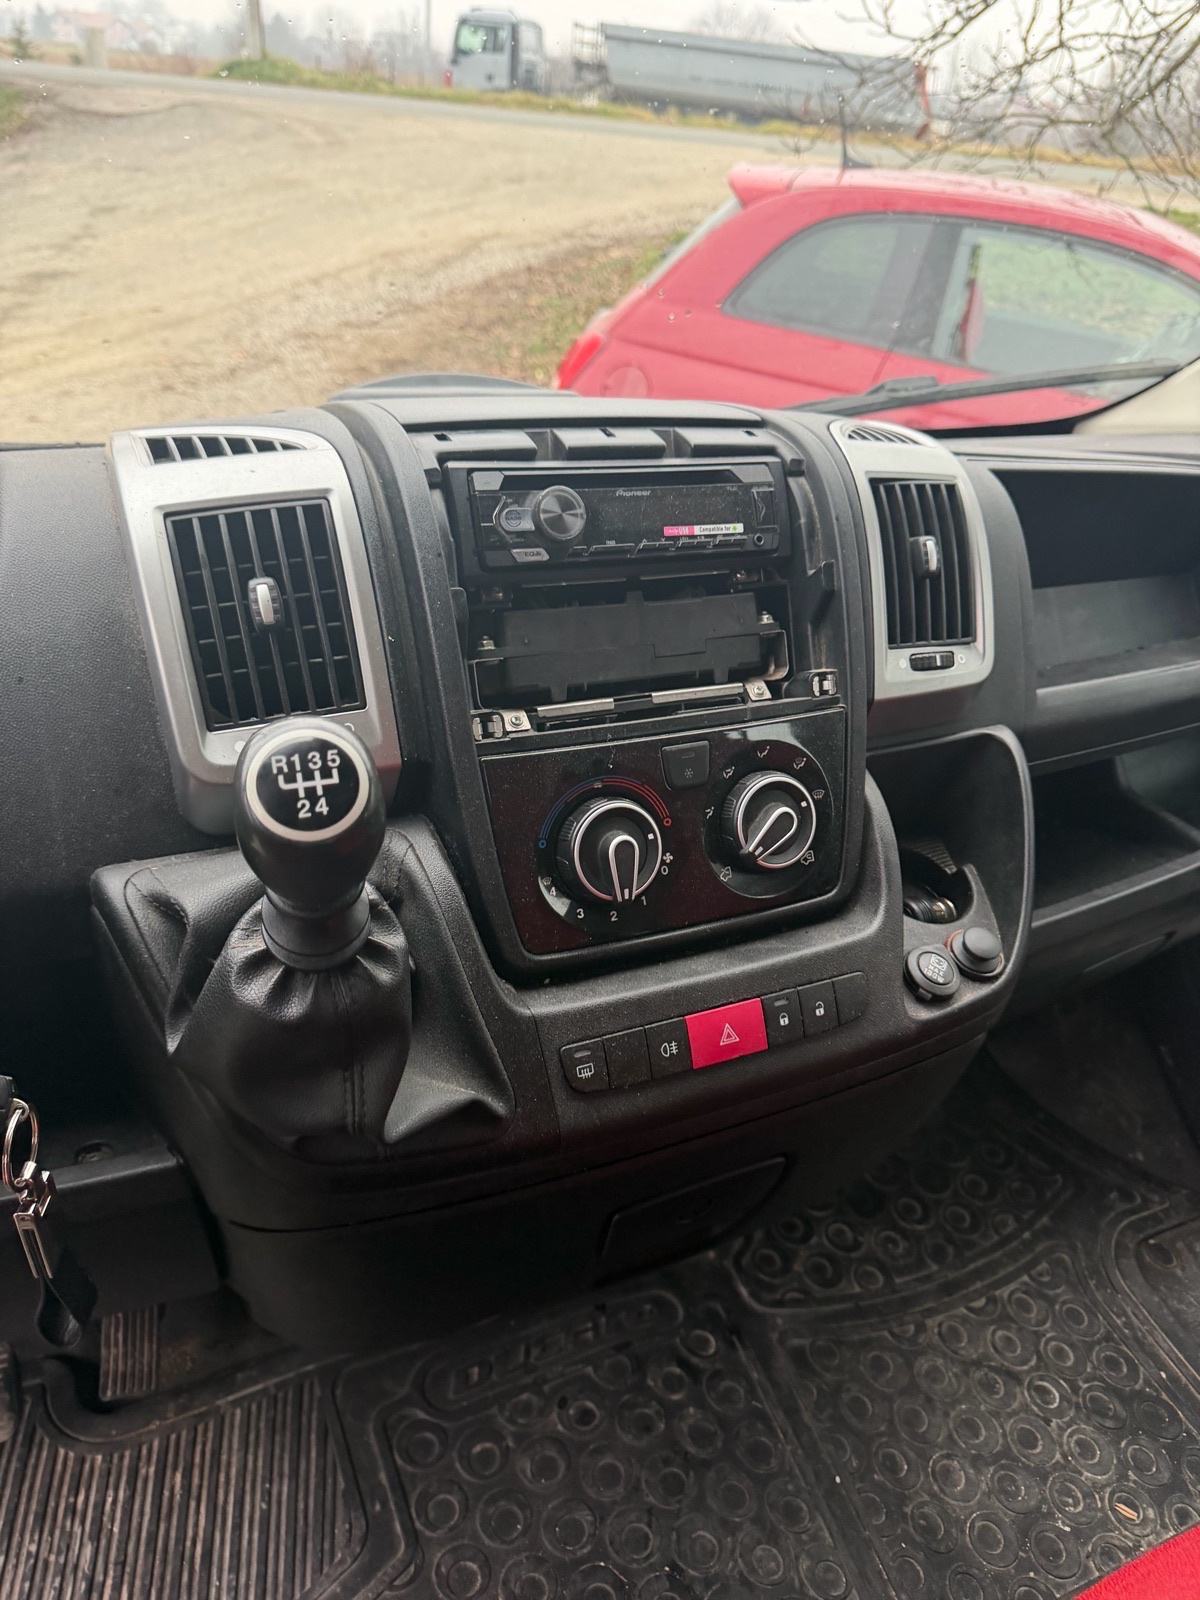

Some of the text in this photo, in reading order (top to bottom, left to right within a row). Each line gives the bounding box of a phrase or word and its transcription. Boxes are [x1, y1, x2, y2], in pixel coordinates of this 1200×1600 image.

[615, 489, 652, 497] Pioneer
[270, 749, 340, 774] R 1 3 5
[297, 797, 329, 818] 2 4
[549, 866, 669, 922] 4 3 2 1 0
